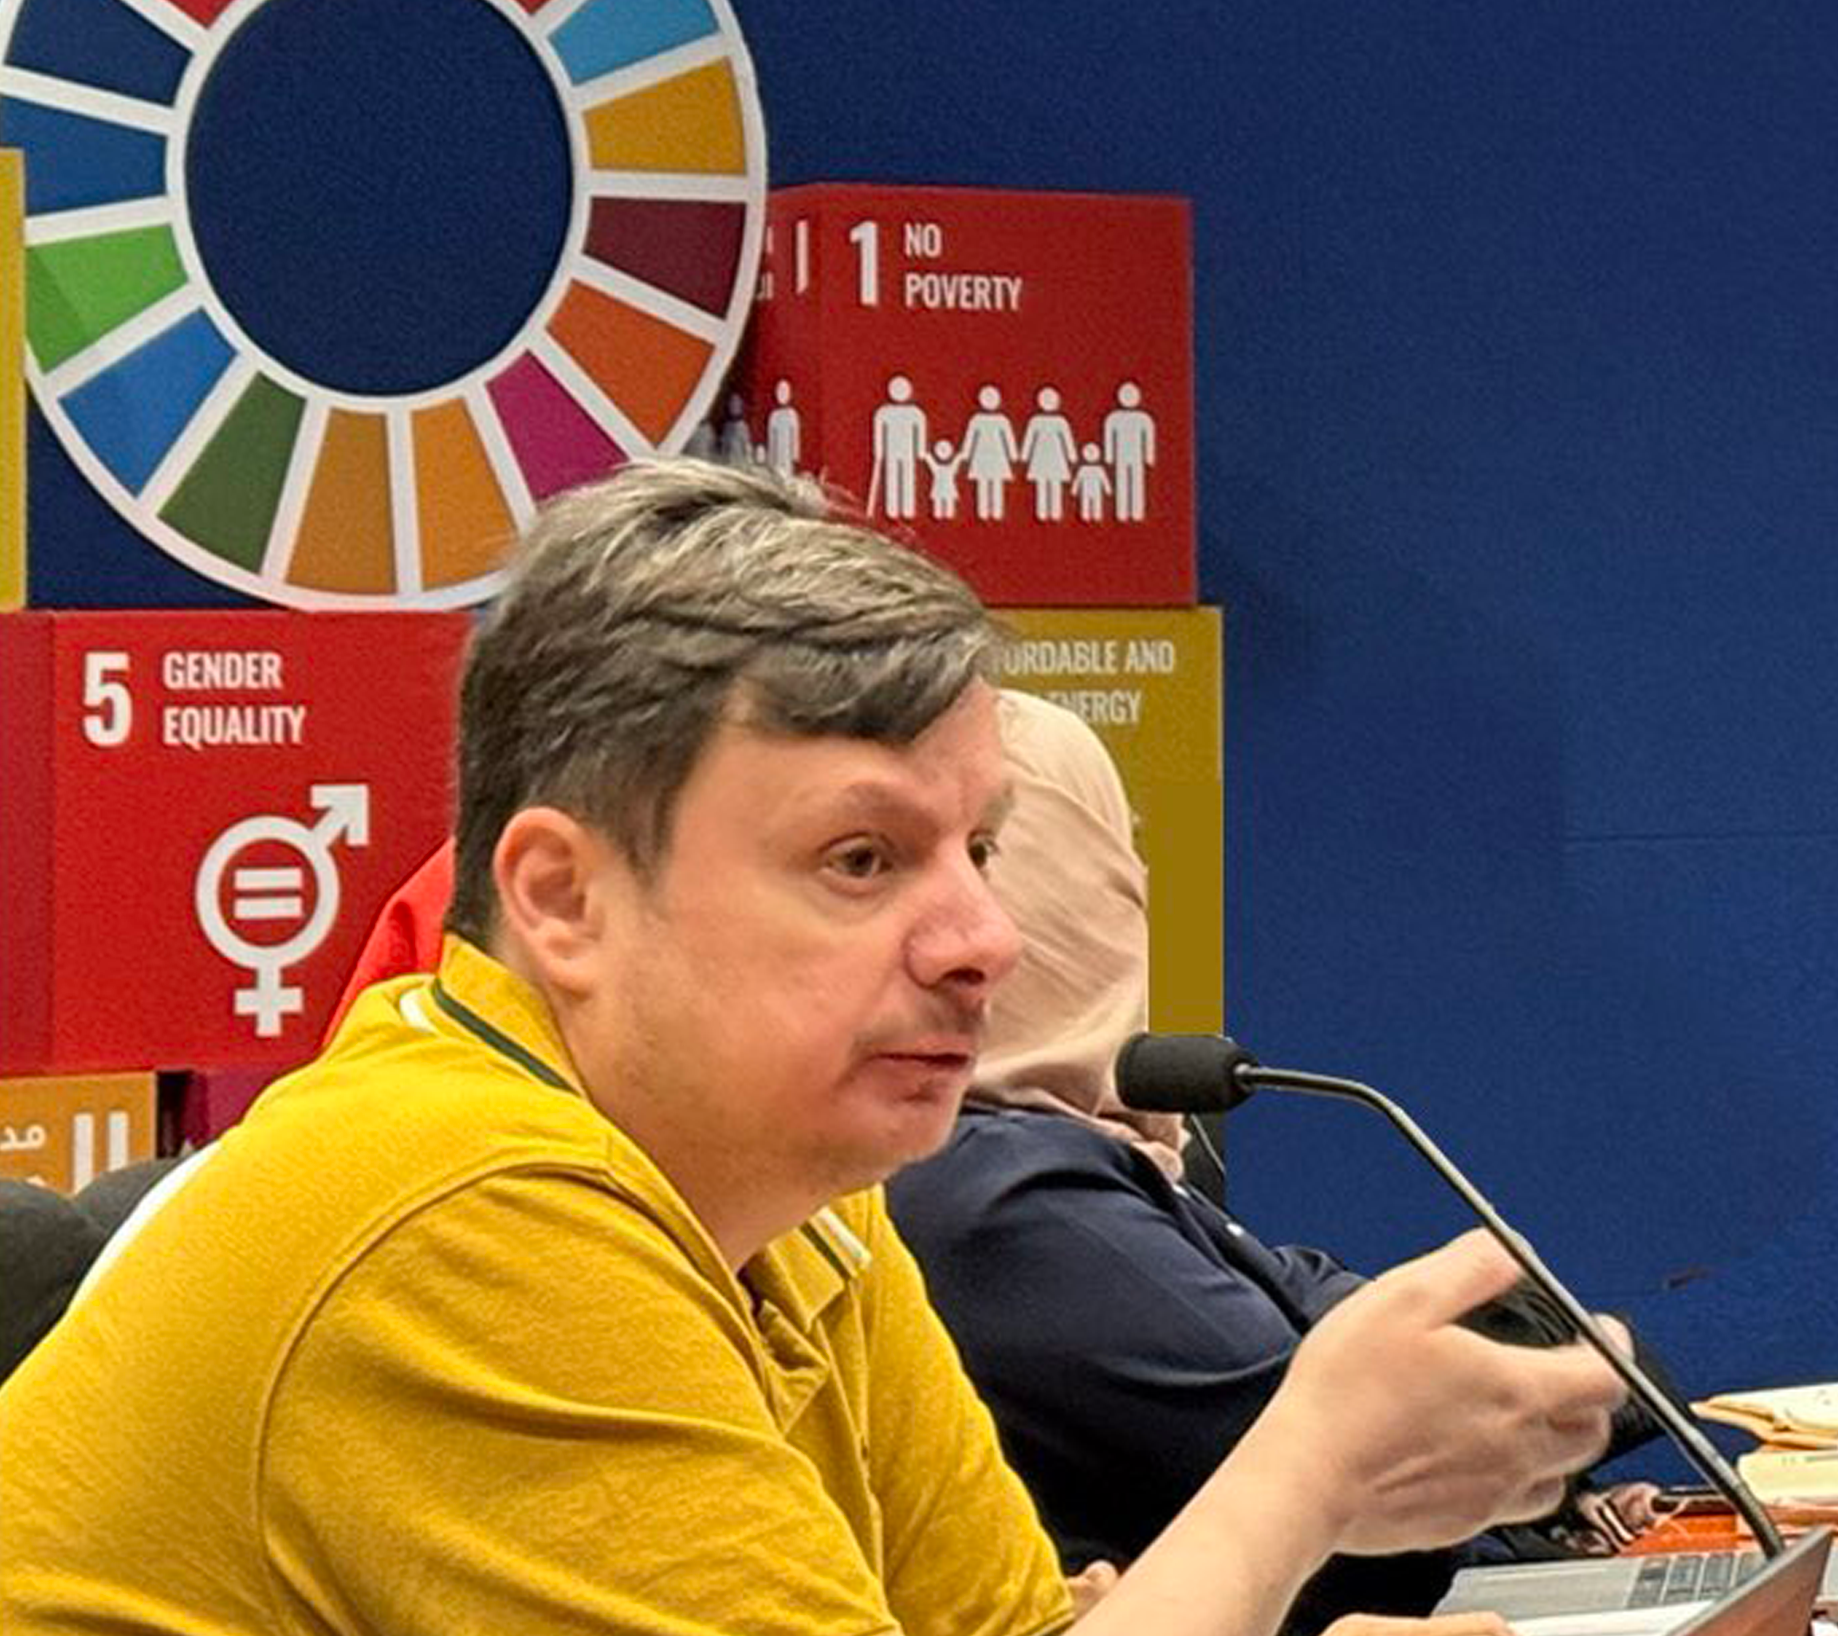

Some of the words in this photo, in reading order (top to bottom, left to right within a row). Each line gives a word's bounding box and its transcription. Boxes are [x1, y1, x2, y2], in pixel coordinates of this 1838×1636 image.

[905, 222, 941, 258] NO
[850, 220, 878, 305] 1
[906, 272, 1022, 310] POVERTY
[162, 651, 283, 690] GENDER
[1125, 637, 1176, 674] AND
[84, 652, 133, 747] 5
[163, 705, 306, 750] EQUALITY
